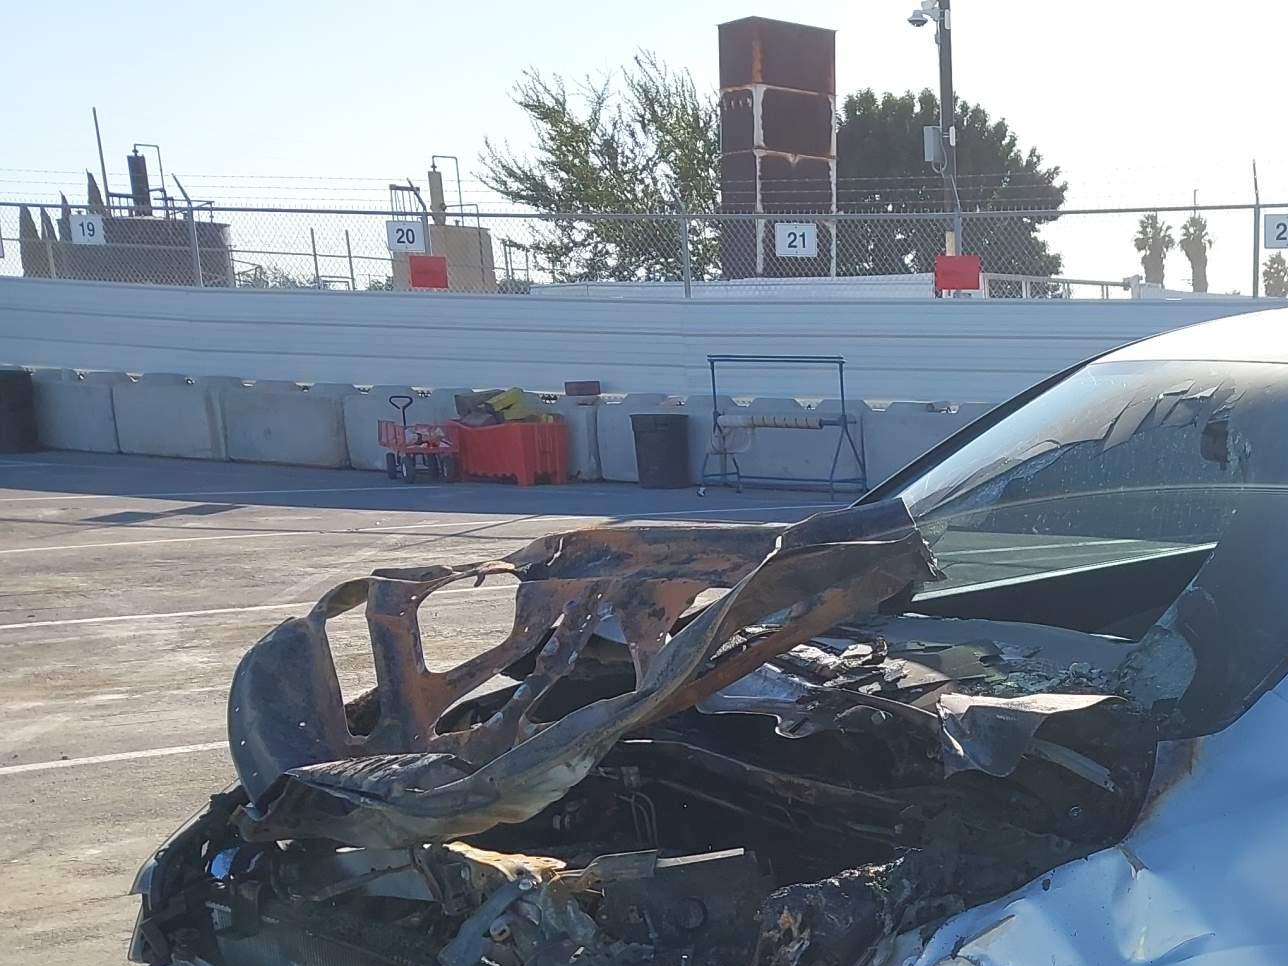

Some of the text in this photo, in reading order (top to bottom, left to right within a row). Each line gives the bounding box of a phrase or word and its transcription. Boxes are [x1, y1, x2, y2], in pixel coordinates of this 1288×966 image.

[79, 221, 95, 237] 19
[396, 228, 415, 244] 20
[787, 231, 805, 248] 21
